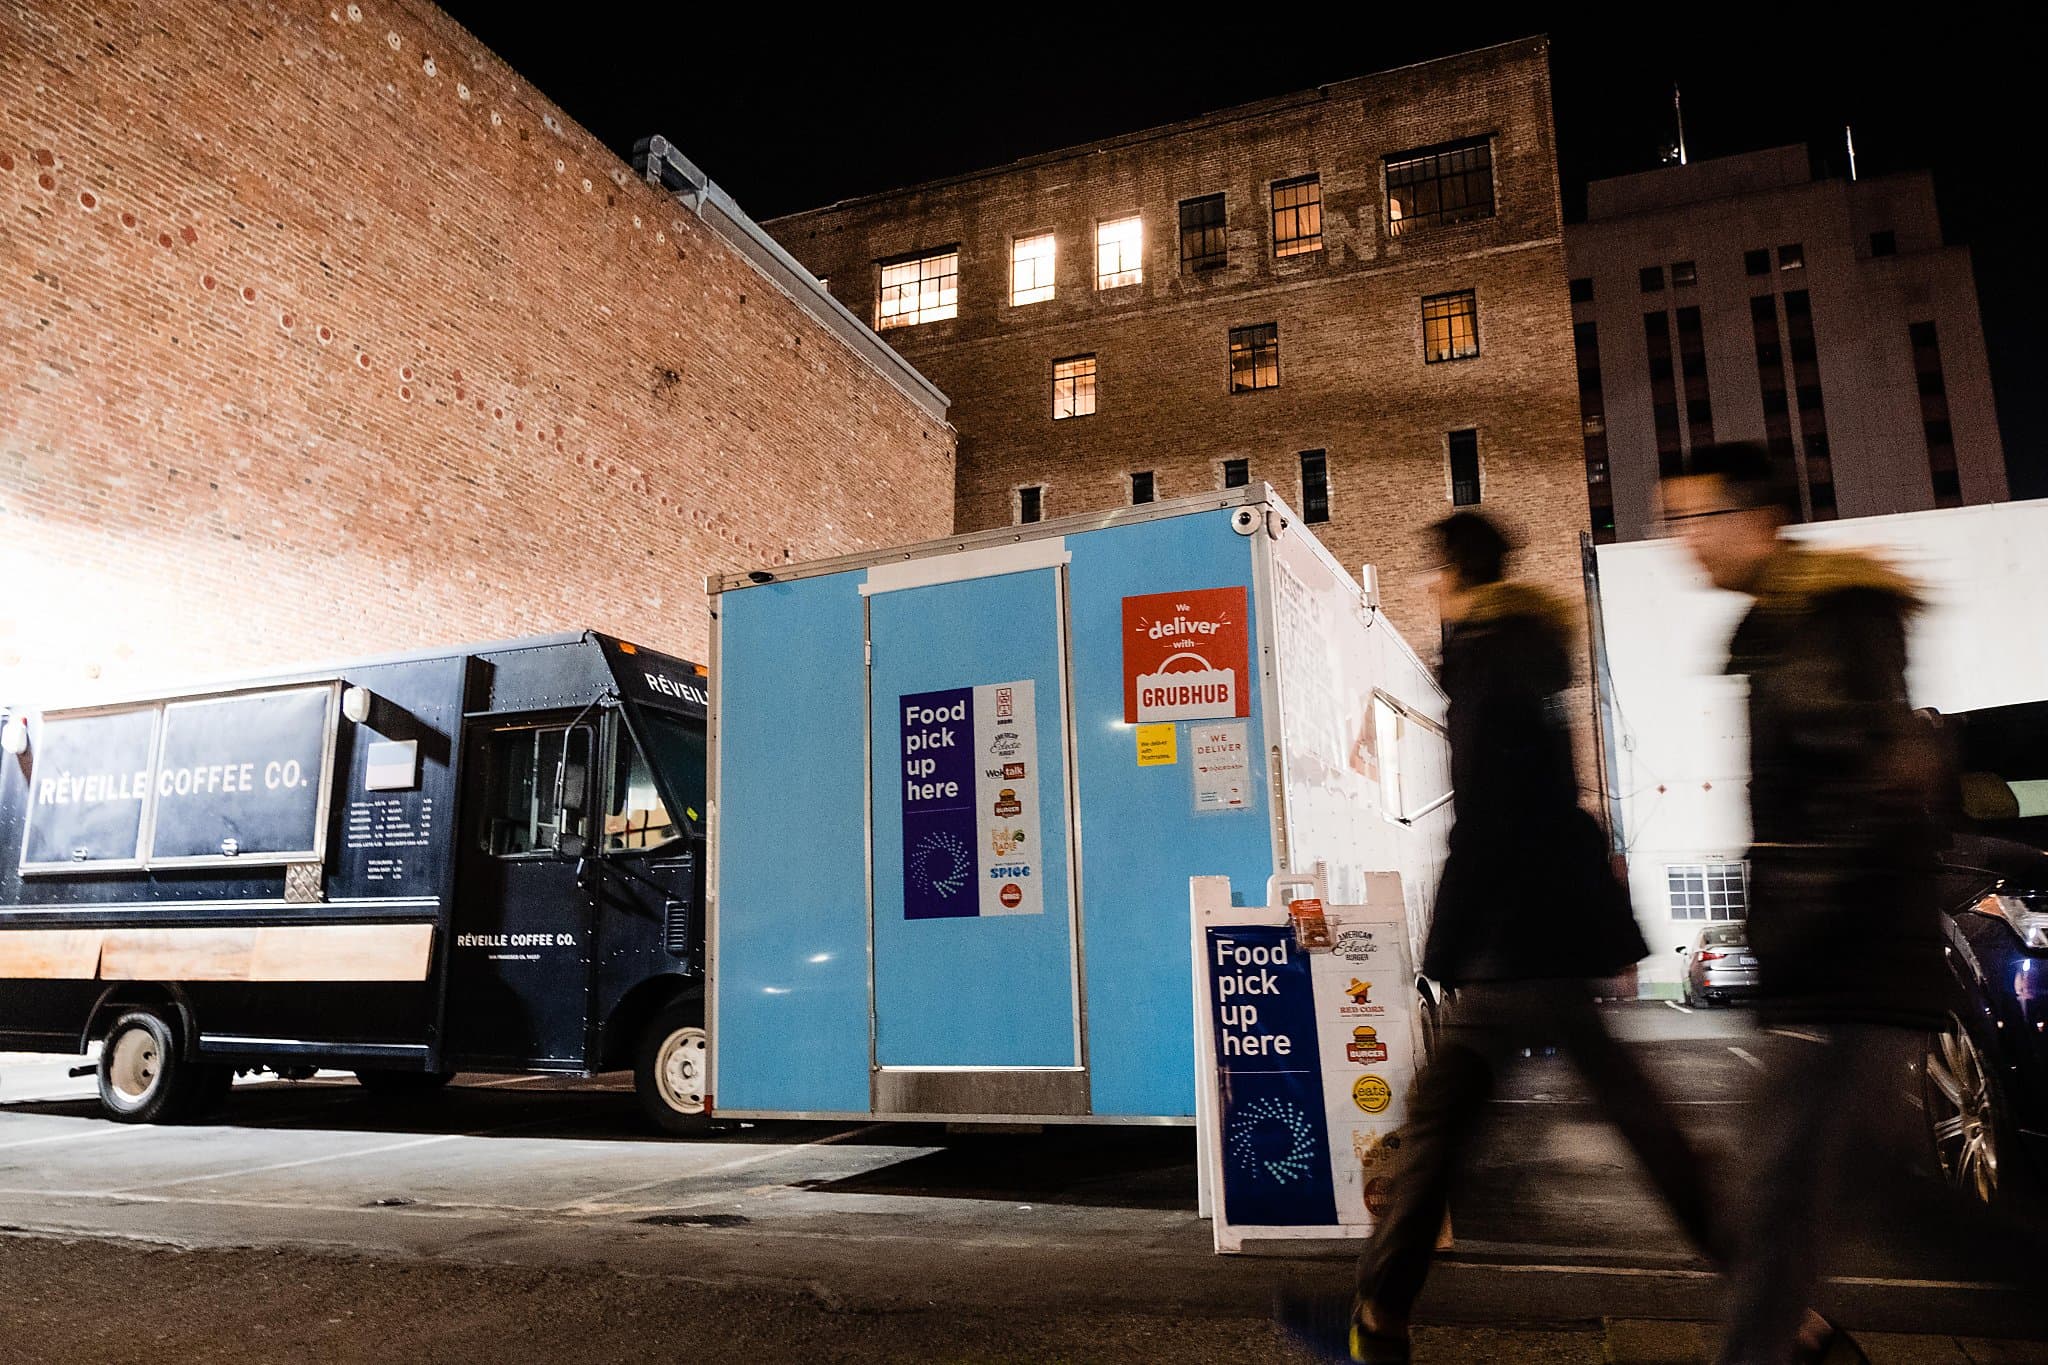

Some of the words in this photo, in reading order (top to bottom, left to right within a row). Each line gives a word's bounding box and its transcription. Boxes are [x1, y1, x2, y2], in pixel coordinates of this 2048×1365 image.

[1175, 603, 1191, 612] We
[1149, 616, 1220, 640] deliver
[1172, 639, 1195, 649] with
[1142, 683, 1229, 708] GRUBHUB
[906, 700, 965, 726] Food
[906, 727, 955, 755] pick
[1210, 734, 1227, 743] WE
[1197, 743, 1242, 755] DELIVER
[907, 758, 936, 779] up
[39, 771, 147, 805] RÉVEILLE
[159, 763, 255, 797] COFFEE
[264, 760, 308, 790] CO.
[907, 780, 959, 800] here
[457, 932, 508, 947] RÉVEILLE
[511, 934, 554, 946] COFFEE
[556, 933, 577, 946] CO.
[1338, 930, 1374, 940] AMERICAN
[1216, 939, 1288, 966] Food
[1345, 953, 1369, 961] BURGER
[1218, 968, 1281, 1003] pick
[1220, 1004, 1258, 1033] up
[1222, 1028, 1291, 1056] here
[1350, 1050, 1385, 1058] BURGER
[1358, 1086, 1386, 1097] eats
